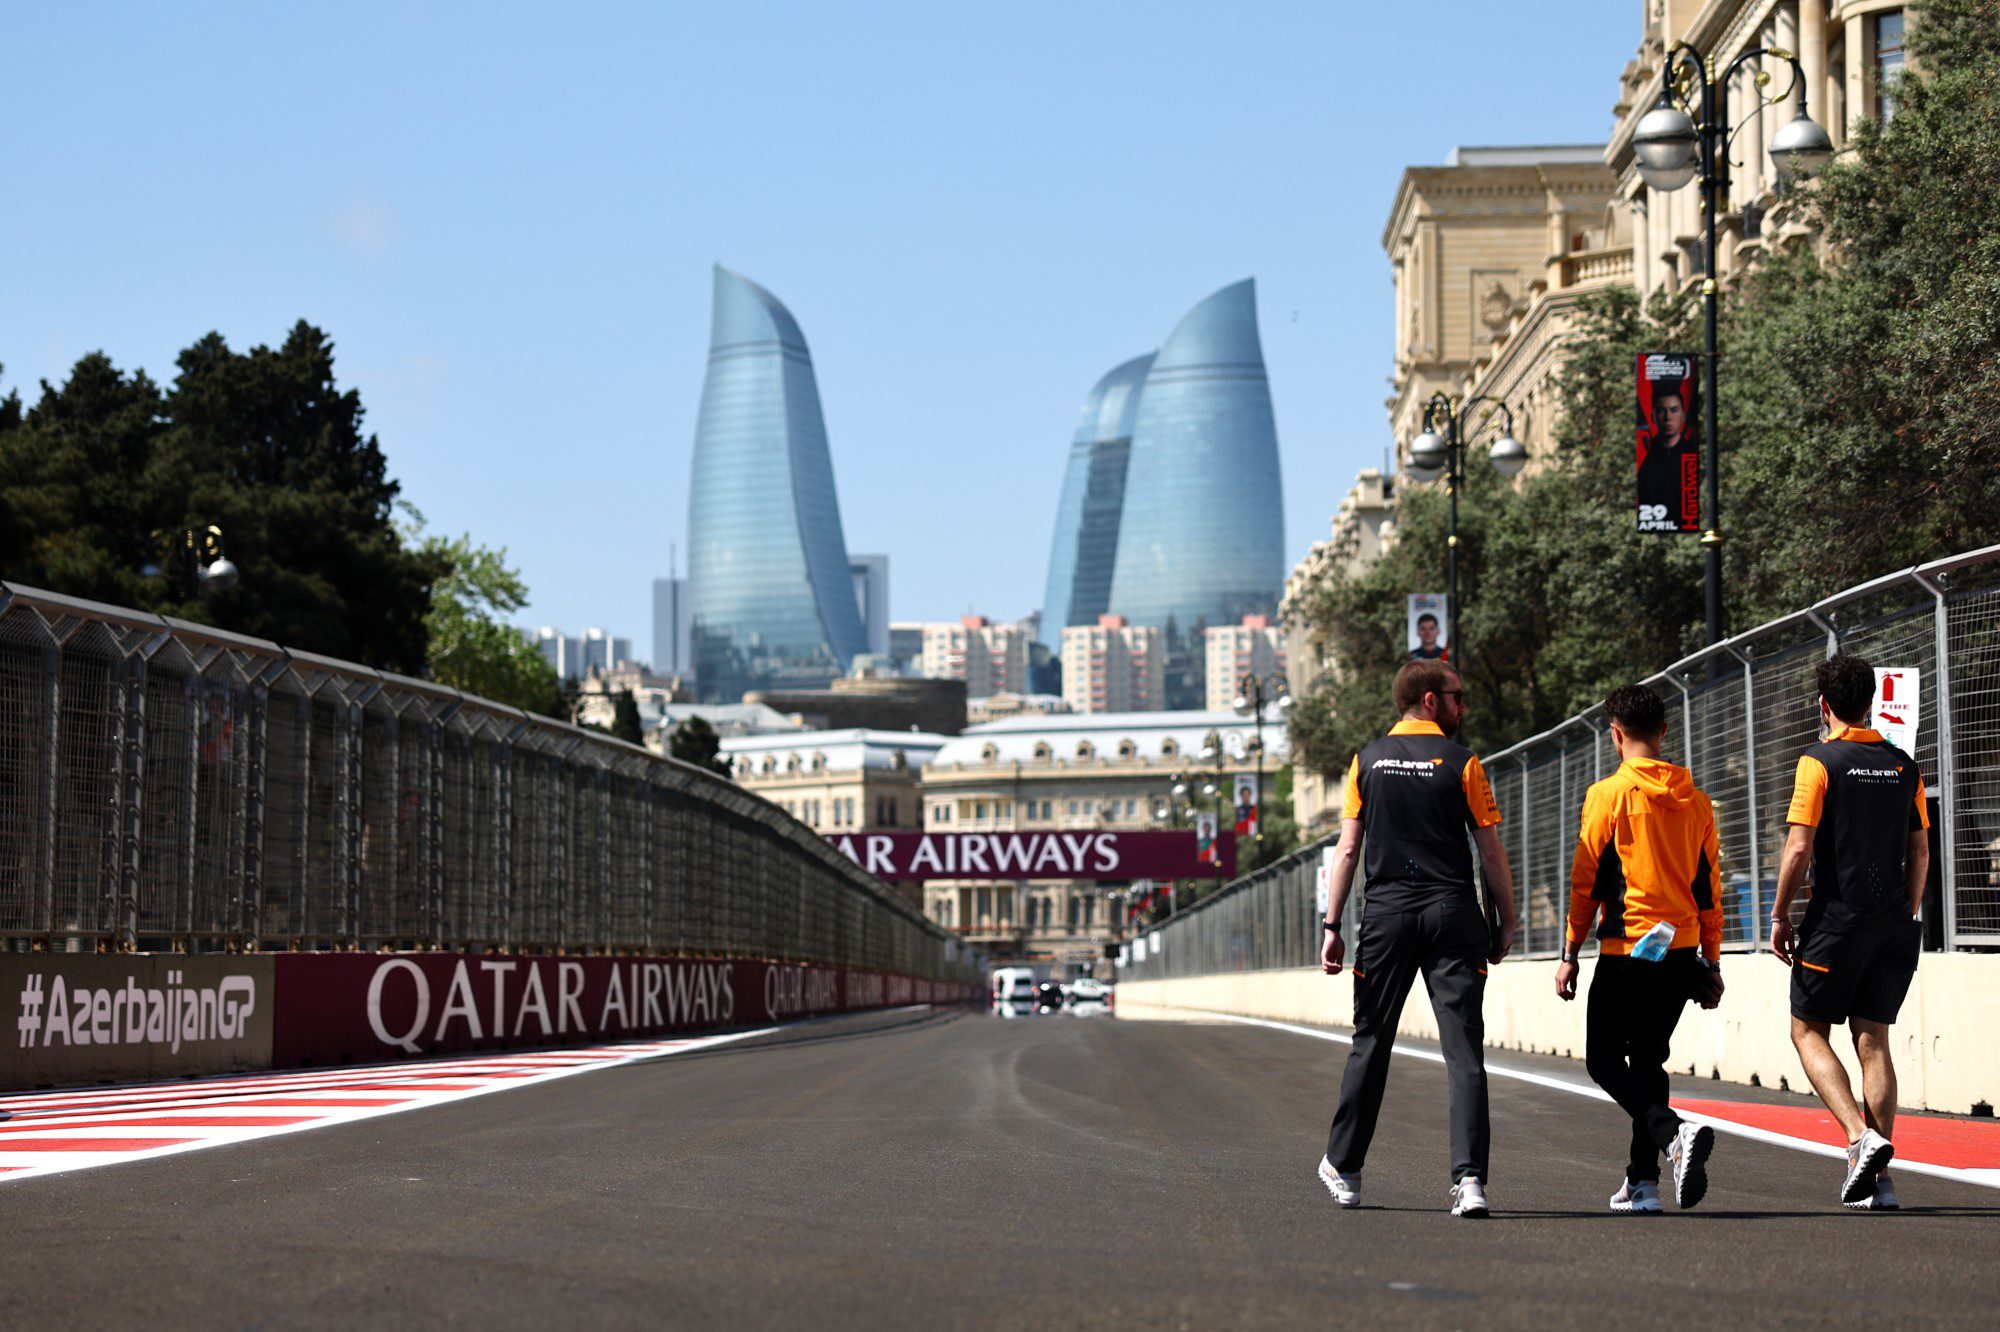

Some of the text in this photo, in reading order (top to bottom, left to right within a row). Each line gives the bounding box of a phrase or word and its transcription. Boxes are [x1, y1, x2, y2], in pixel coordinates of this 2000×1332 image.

[1681, 453, 1699, 530] Hardwell
[1638, 504, 1668, 521] 29
[1638, 520, 1678, 531] APRIL
[1372, 759, 1434, 770] McLaren
[1846, 768, 1899, 777] McLaren
[824, 833, 1120, 874] AR AIRWAYS
[18, 970, 256, 1055] #AzerbaijanGP
[366, 958, 587, 1054] QATAR
[600, 962, 734, 1031] AIRWAYS
